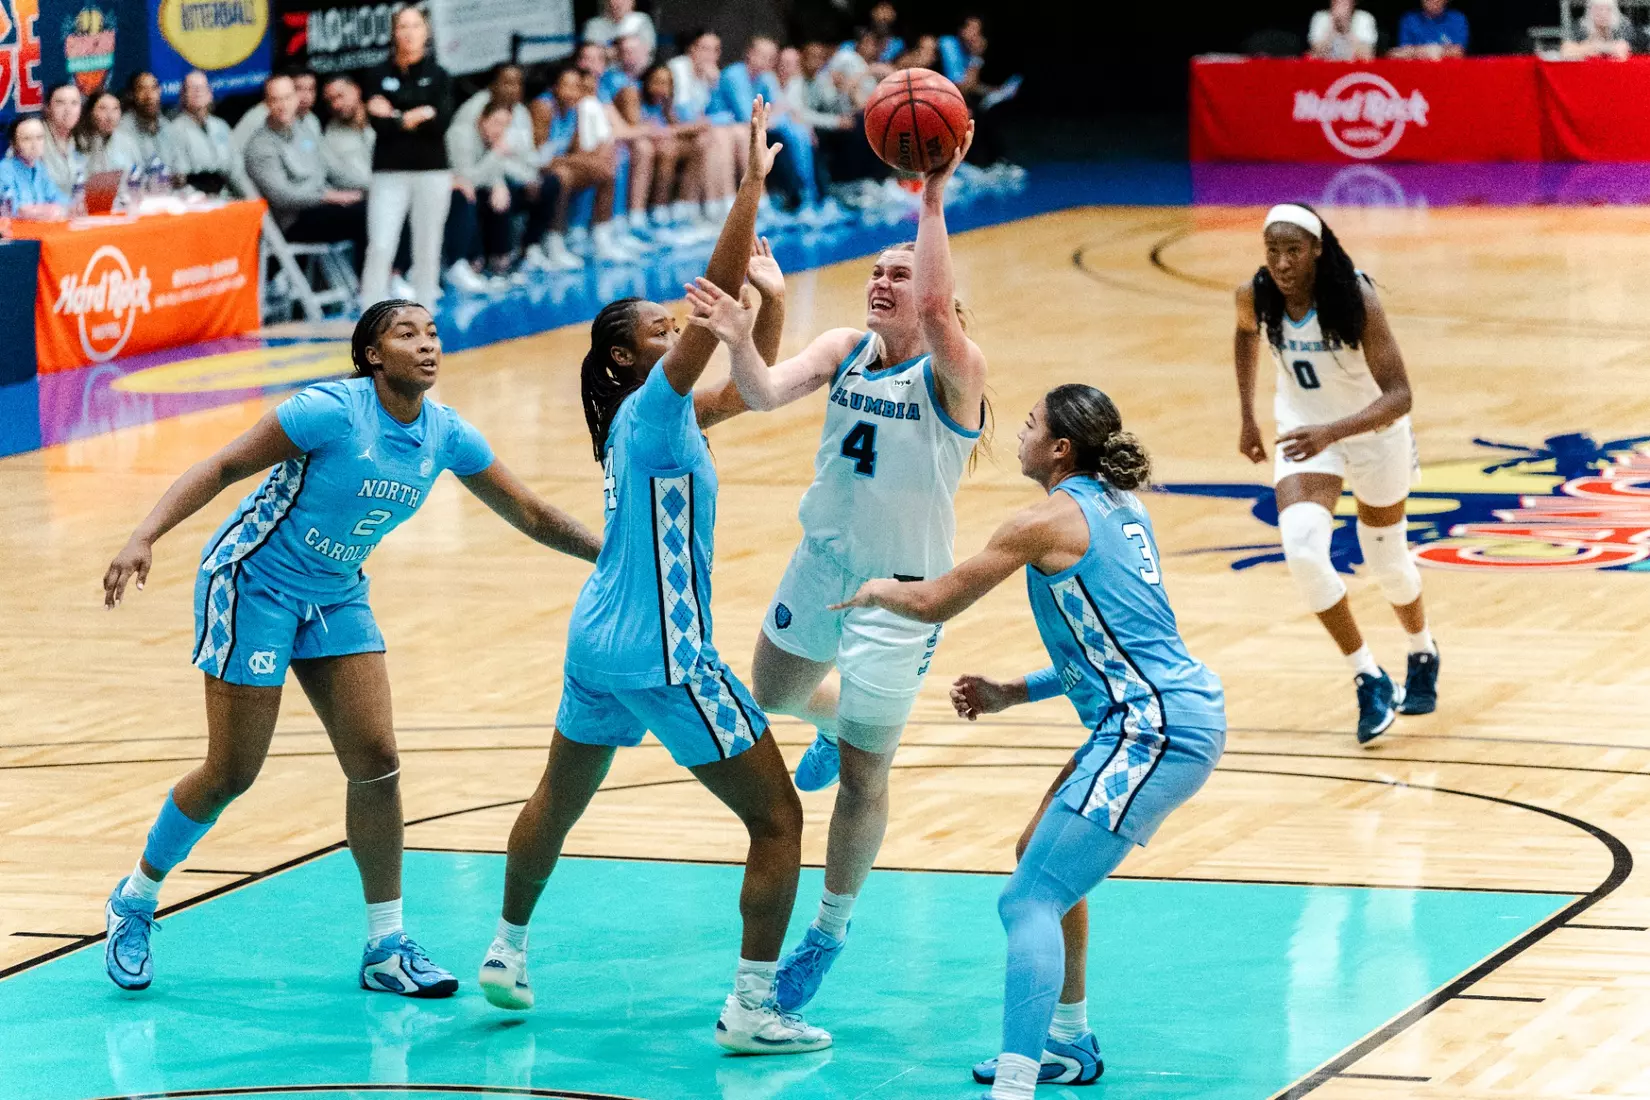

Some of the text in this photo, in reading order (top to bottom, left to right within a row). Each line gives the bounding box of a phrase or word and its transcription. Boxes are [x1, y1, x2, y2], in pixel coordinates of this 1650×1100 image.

[1293, 89, 1430, 128] Hard Rock
[53, 272, 108, 315] Hard
[107, 265, 152, 319] Rock
[1292, 359, 1321, 390] 0
[839, 418, 878, 479] 4
[357, 479, 421, 508] NORTH
[352, 508, 392, 537] 2
[1121, 521, 1160, 586] 3
